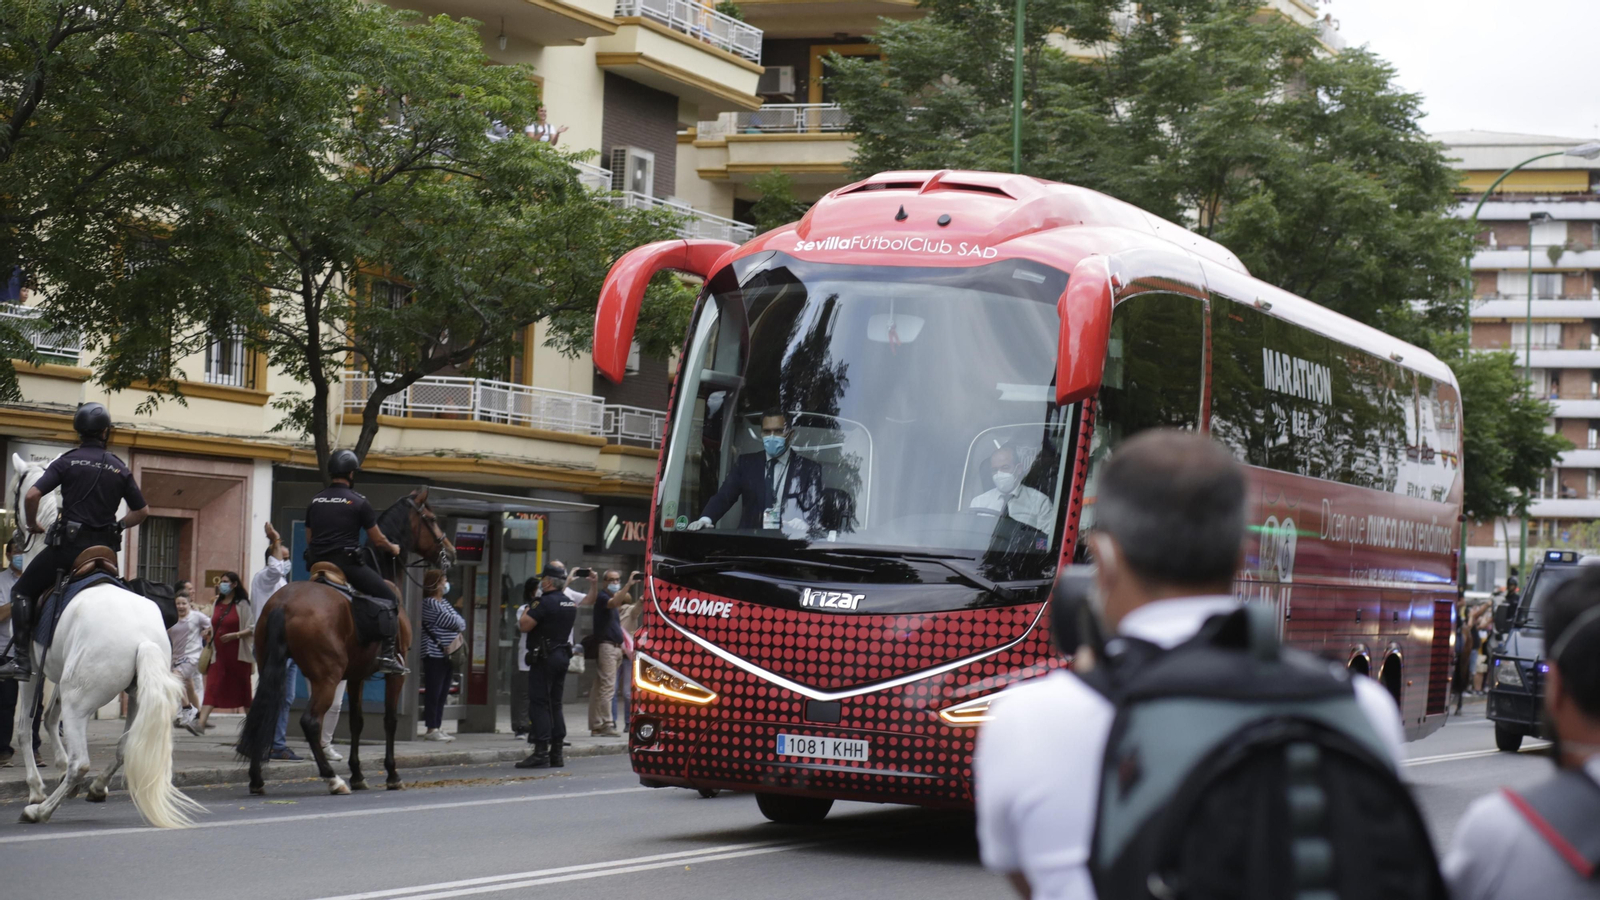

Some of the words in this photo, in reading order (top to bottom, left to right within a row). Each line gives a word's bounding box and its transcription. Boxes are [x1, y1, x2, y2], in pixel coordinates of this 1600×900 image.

[957, 241, 998, 259] SAD
[1262, 347, 1333, 406] MARATHON
[1320, 498, 1347, 542] Dicen
[1348, 515, 1366, 556] que
[1366, 514, 1398, 549] nunca
[1398, 519, 1415, 551] nos
[1414, 515, 1452, 555] rendimos
[669, 596, 733, 619] ALOMPE
[802, 587, 866, 611] Irizar
[790, 738, 825, 755] 1081
[833, 741, 863, 758] KHH
